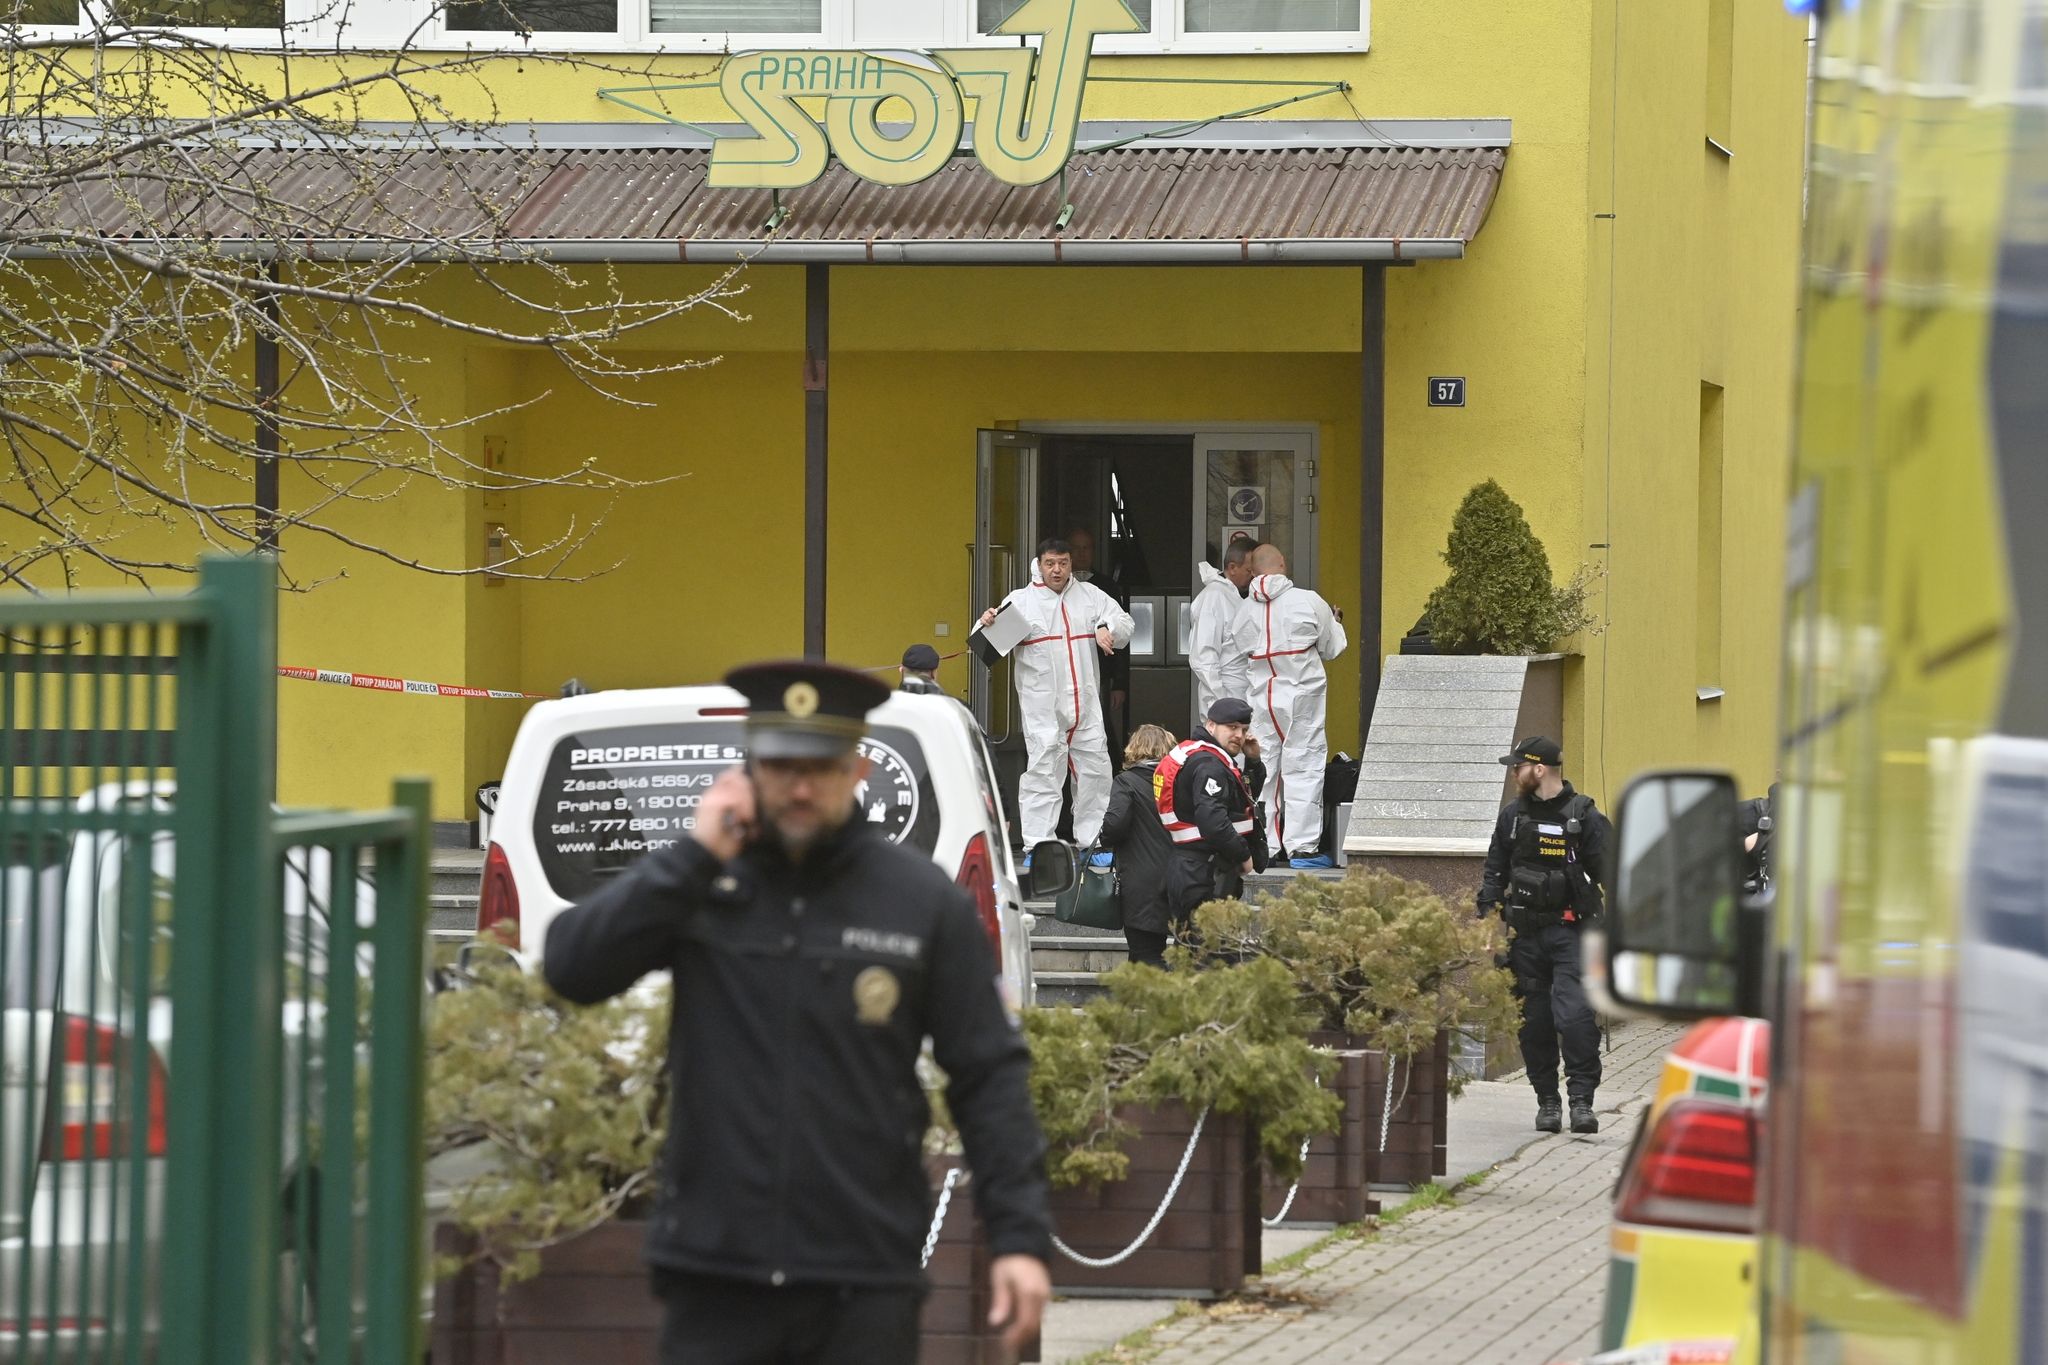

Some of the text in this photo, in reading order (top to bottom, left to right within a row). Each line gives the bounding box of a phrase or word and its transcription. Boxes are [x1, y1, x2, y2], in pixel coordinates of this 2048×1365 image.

[758, 55, 884, 91] PRAHA
[1438, 383, 1456, 401] 57
[319, 672, 342, 684] POLICIE
[342, 673, 351, 685] ČR
[354, 676, 373, 687] VSTUP
[373, 677, 402, 690] ZAKÁZÁN
[406, 682, 429, 692] POLICIE
[441, 686, 460, 695] VSTUP
[571, 744, 720, 765] PROPRETTE
[562, 775, 649, 792] Zásadská
[557, 799, 611, 813] Praha
[551, 821, 586, 835] tel.:
[589, 818, 627, 833] 777
[629, 817, 668, 832] 880
[1539, 836, 1566, 845] POLICIE
